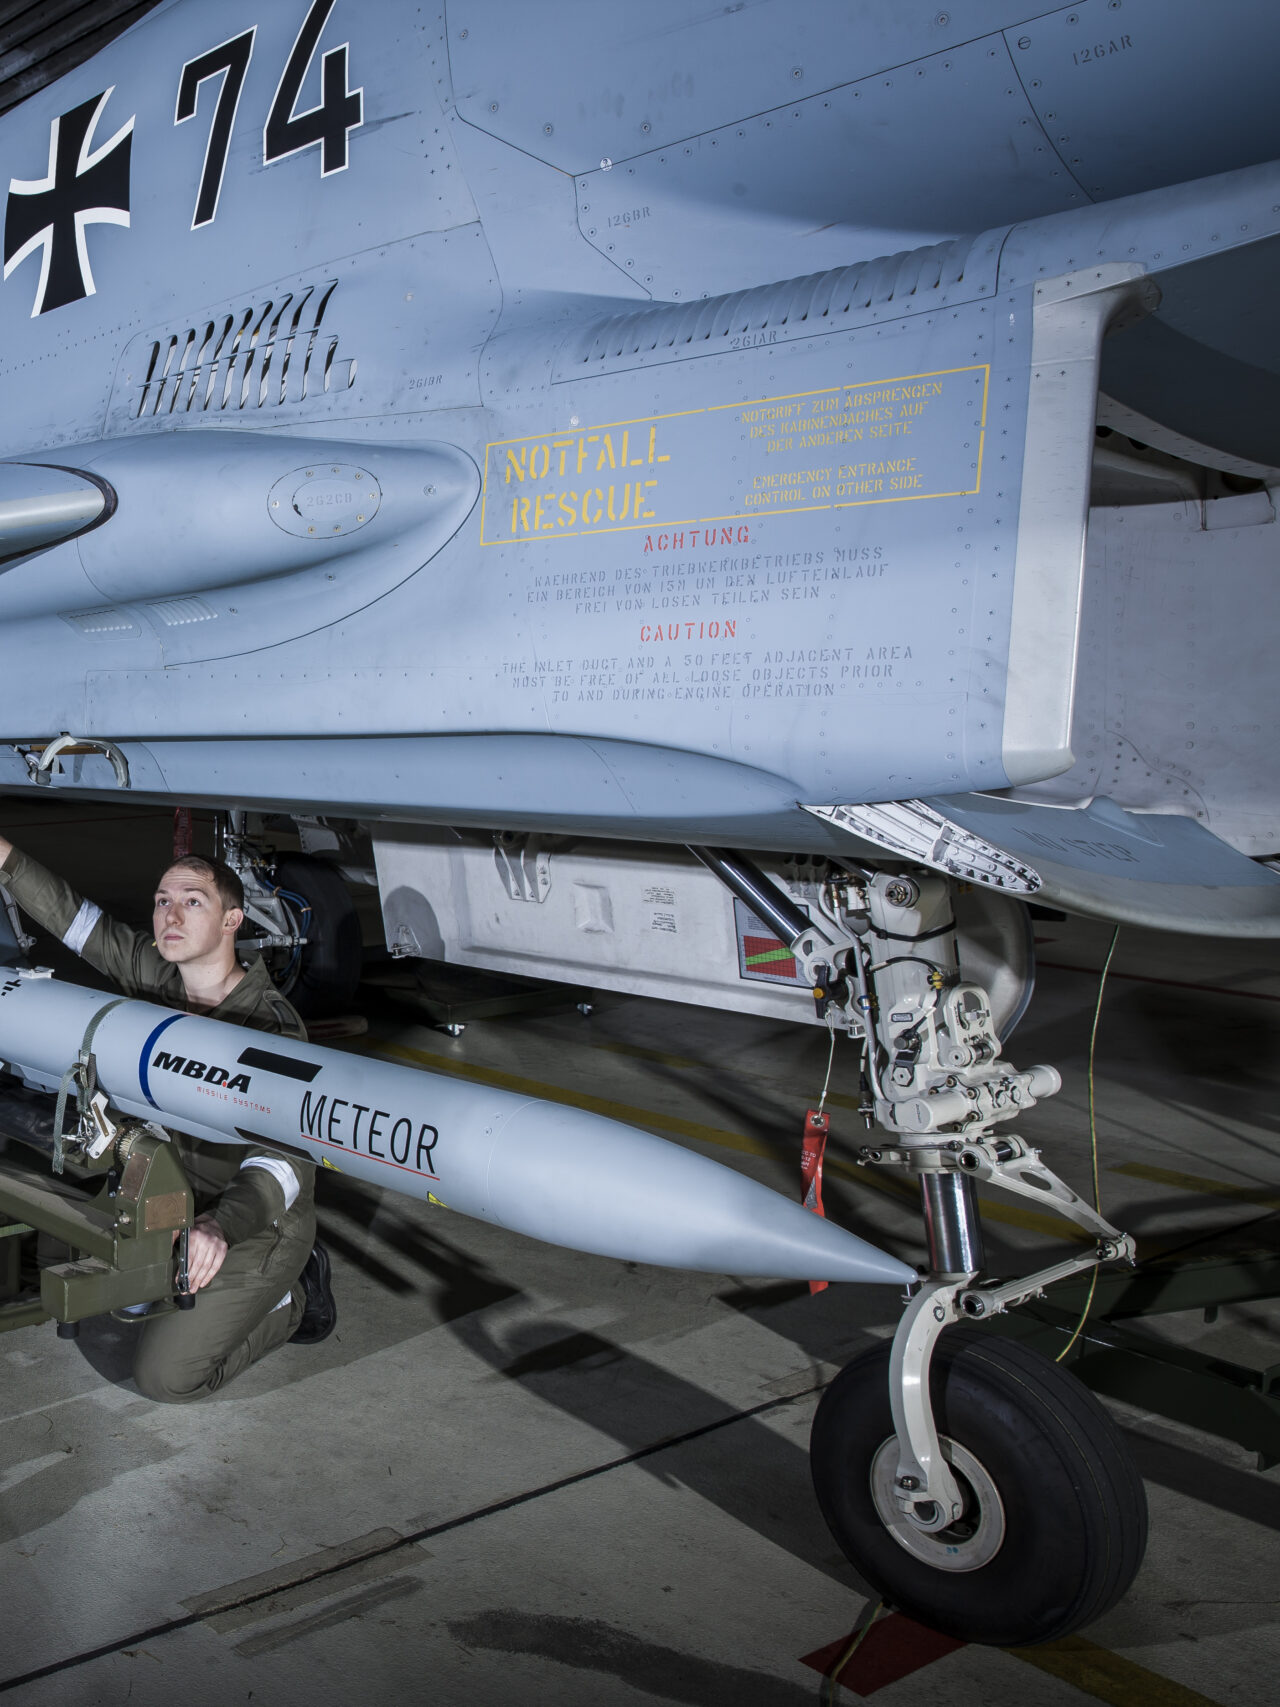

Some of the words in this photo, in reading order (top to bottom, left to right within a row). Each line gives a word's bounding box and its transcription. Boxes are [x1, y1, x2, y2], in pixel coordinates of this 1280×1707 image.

[174, 0, 364, 230] 74
[741, 402, 807, 424] NOTGRIFF
[812, 397, 840, 414] ZUM
[844, 382, 943, 408] ABSPRENGEN
[750, 423, 776, 439] DES
[781, 407, 893, 434] KABINENDACHES
[899, 401, 929, 418] AUF
[767, 436, 793, 453] DER
[799, 428, 864, 449] ANDEREN
[870, 420, 913, 439] SEITE
[505, 426, 671, 484] NOTFALL
[744, 489, 806, 507] CONTROL
[812, 485, 831, 499] ON
[836, 479, 884, 496] OTHER
[890, 473, 924, 491] SIDE
[753, 467, 833, 489] EMERGENCY
[838, 457, 918, 480] ENTRANCE
[511, 480, 658, 533] RESCUE
[643, 525, 750, 553] ACHTUNG
[615, 567, 642, 581] DES
[834, 546, 883, 563] MUSS
[527, 590, 549, 604] EIN
[556, 585, 616, 601] BEREICH
[625, 581, 652, 596] VON
[696, 577, 715, 590] UM
[725, 574, 756, 588] DEN
[766, 563, 889, 585] LUFTEINLAUF
[575, 602, 607, 615] FREI
[616, 598, 643, 613] VON
[651, 594, 701, 609] LOSEN
[712, 589, 770, 605] TEILEN
[781, 586, 820, 600] SEIN
[640, 620, 737, 643] CAUTION
[502, 662, 526, 674] THE
[534, 659, 574, 674] INLET
[582, 658, 619, 671] DUCT
[627, 656, 654, 670] AND
[664, 655, 672, 668] A
[684, 654, 704, 667] 50
[711, 651, 753, 666] FEET
[764, 647, 854, 664] ADJACENT
[866, 645, 914, 661] AREA
[554, 674, 572, 688] BE
[580, 673, 617, 687] FREE
[625, 672, 644, 685] OF
[690, 668, 742, 682] LOOSE
[752, 665, 829, 682] OBJECTS
[841, 664, 894, 679] PRIOR
[552, 690, 569, 703] TO
[577, 689, 604, 702] AND
[613, 687, 666, 701] DURING
[674, 684, 732, 701] ENGINE
[742, 683, 836, 698] OPERATION
[152, 1051, 252, 1094] MBDA
[196, 1086, 228, 1101] MISSILE
[233, 1097, 271, 1114] SYSTEMS
[300, 1089, 439, 1175] METEOR
